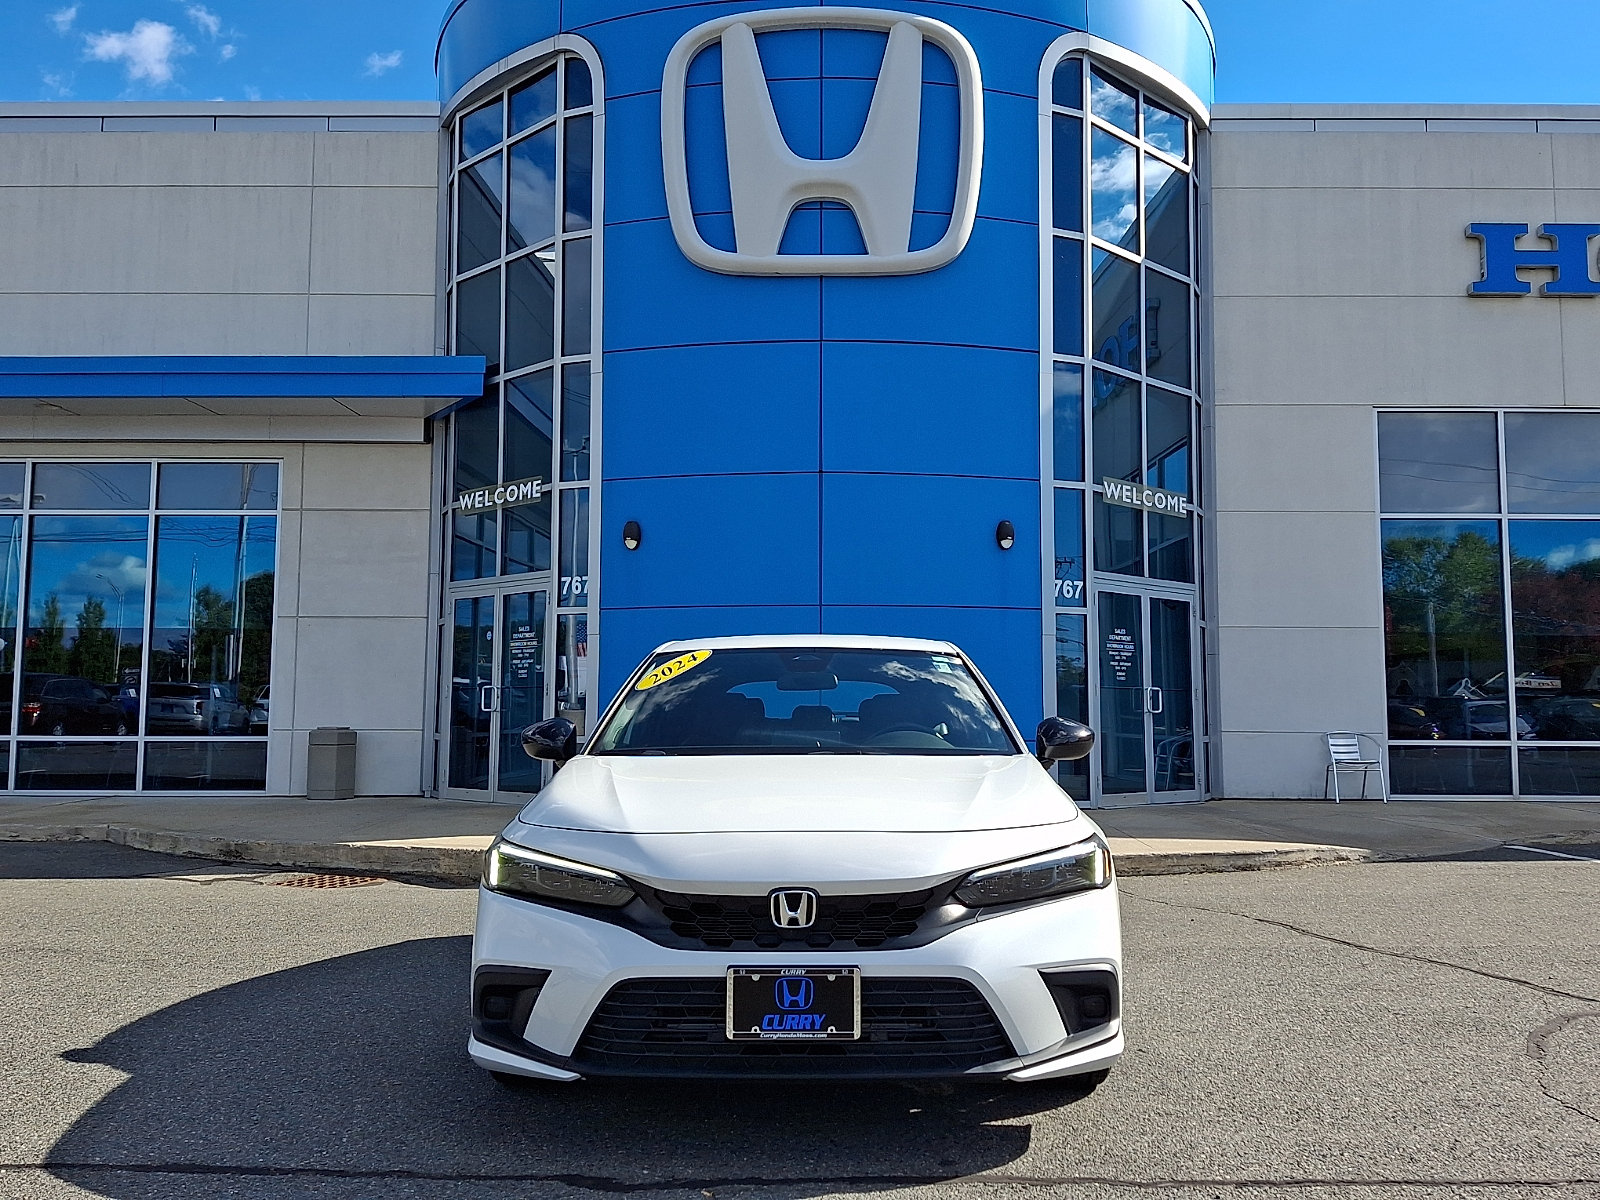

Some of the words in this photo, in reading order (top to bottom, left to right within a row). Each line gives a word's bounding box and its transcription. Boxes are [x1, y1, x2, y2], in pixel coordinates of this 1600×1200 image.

[1465, 222, 1600, 298] H
[459, 479, 542, 511] WELCOME
[1103, 480, 1187, 515] WELCOME
[561, 576, 589, 595] 767
[1054, 579, 1084, 600] 767
[648, 653, 699, 685] 2024
[780, 968, 807, 976] CURRY
[762, 1013, 826, 1030] CURRY
